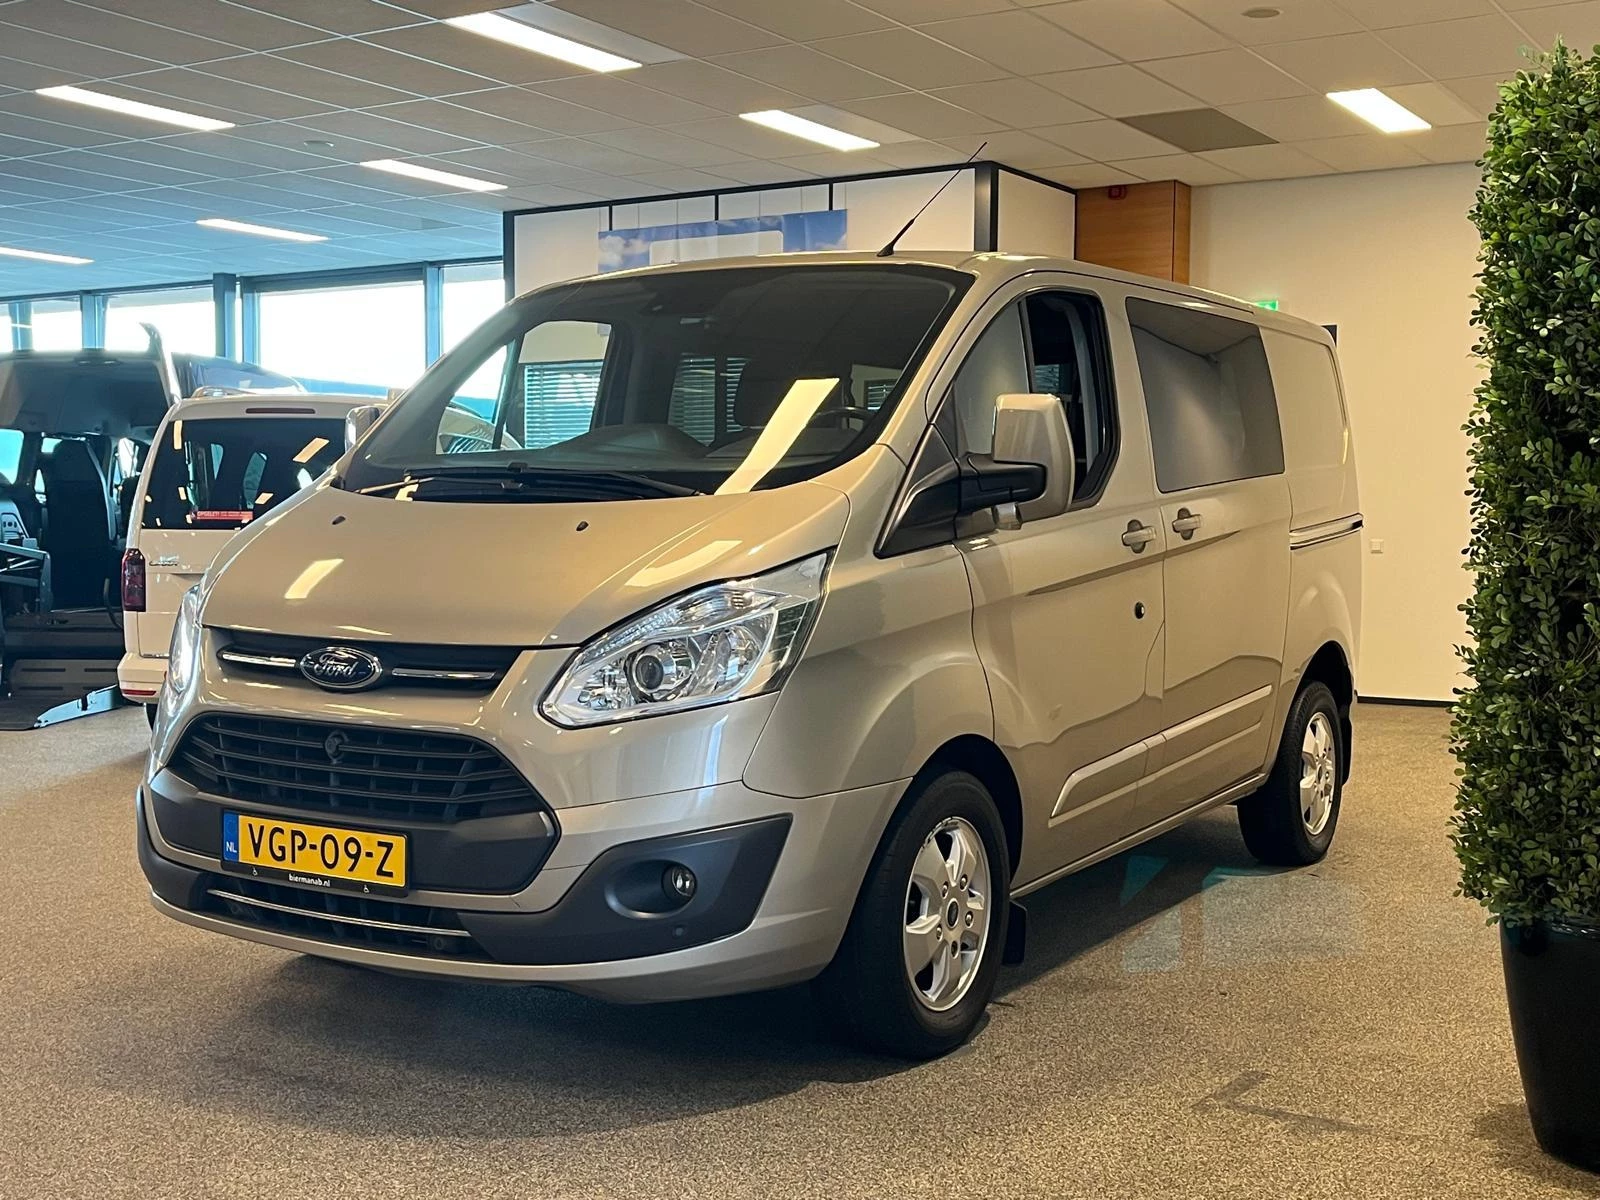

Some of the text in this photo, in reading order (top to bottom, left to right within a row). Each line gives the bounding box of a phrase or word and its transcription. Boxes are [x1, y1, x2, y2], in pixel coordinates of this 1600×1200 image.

[313, 652, 359, 678] Ford
[225, 841, 238, 853] NL
[247, 822, 394, 879] VGP-09-Z
[288, 873, 331, 888] biermanab.nl
